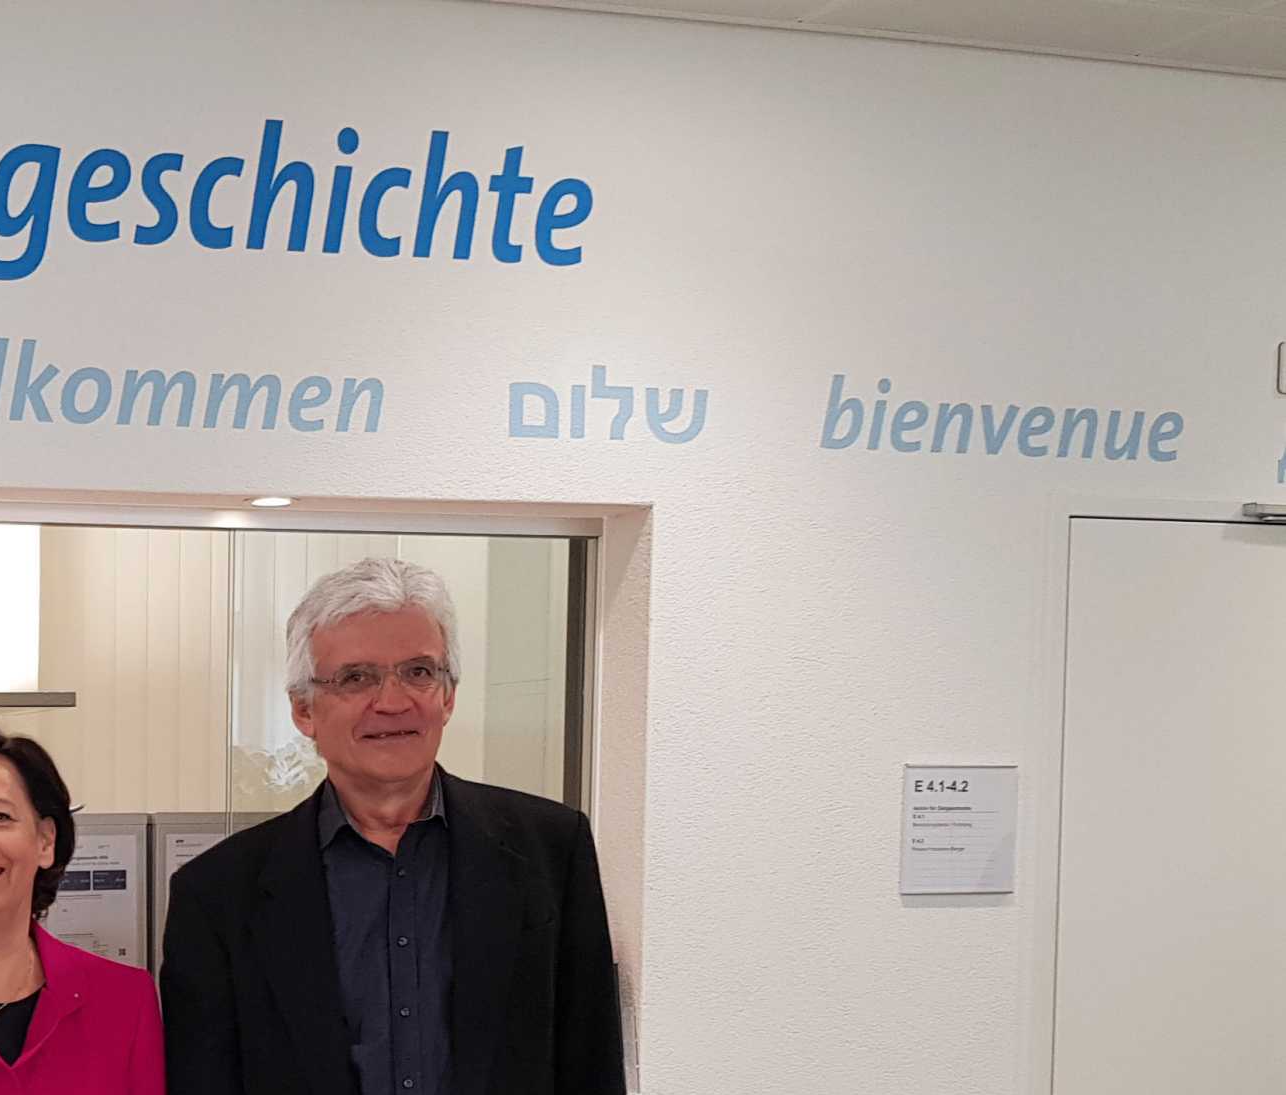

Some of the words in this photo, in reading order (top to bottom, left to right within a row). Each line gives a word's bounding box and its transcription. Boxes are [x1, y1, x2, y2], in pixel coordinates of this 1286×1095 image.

[507, 364, 709, 445] שלום
[822, 375, 1183, 463] bienvenue
[914, 780, 923, 793] E
[926, 780, 969, 793] 4.1-4.2
